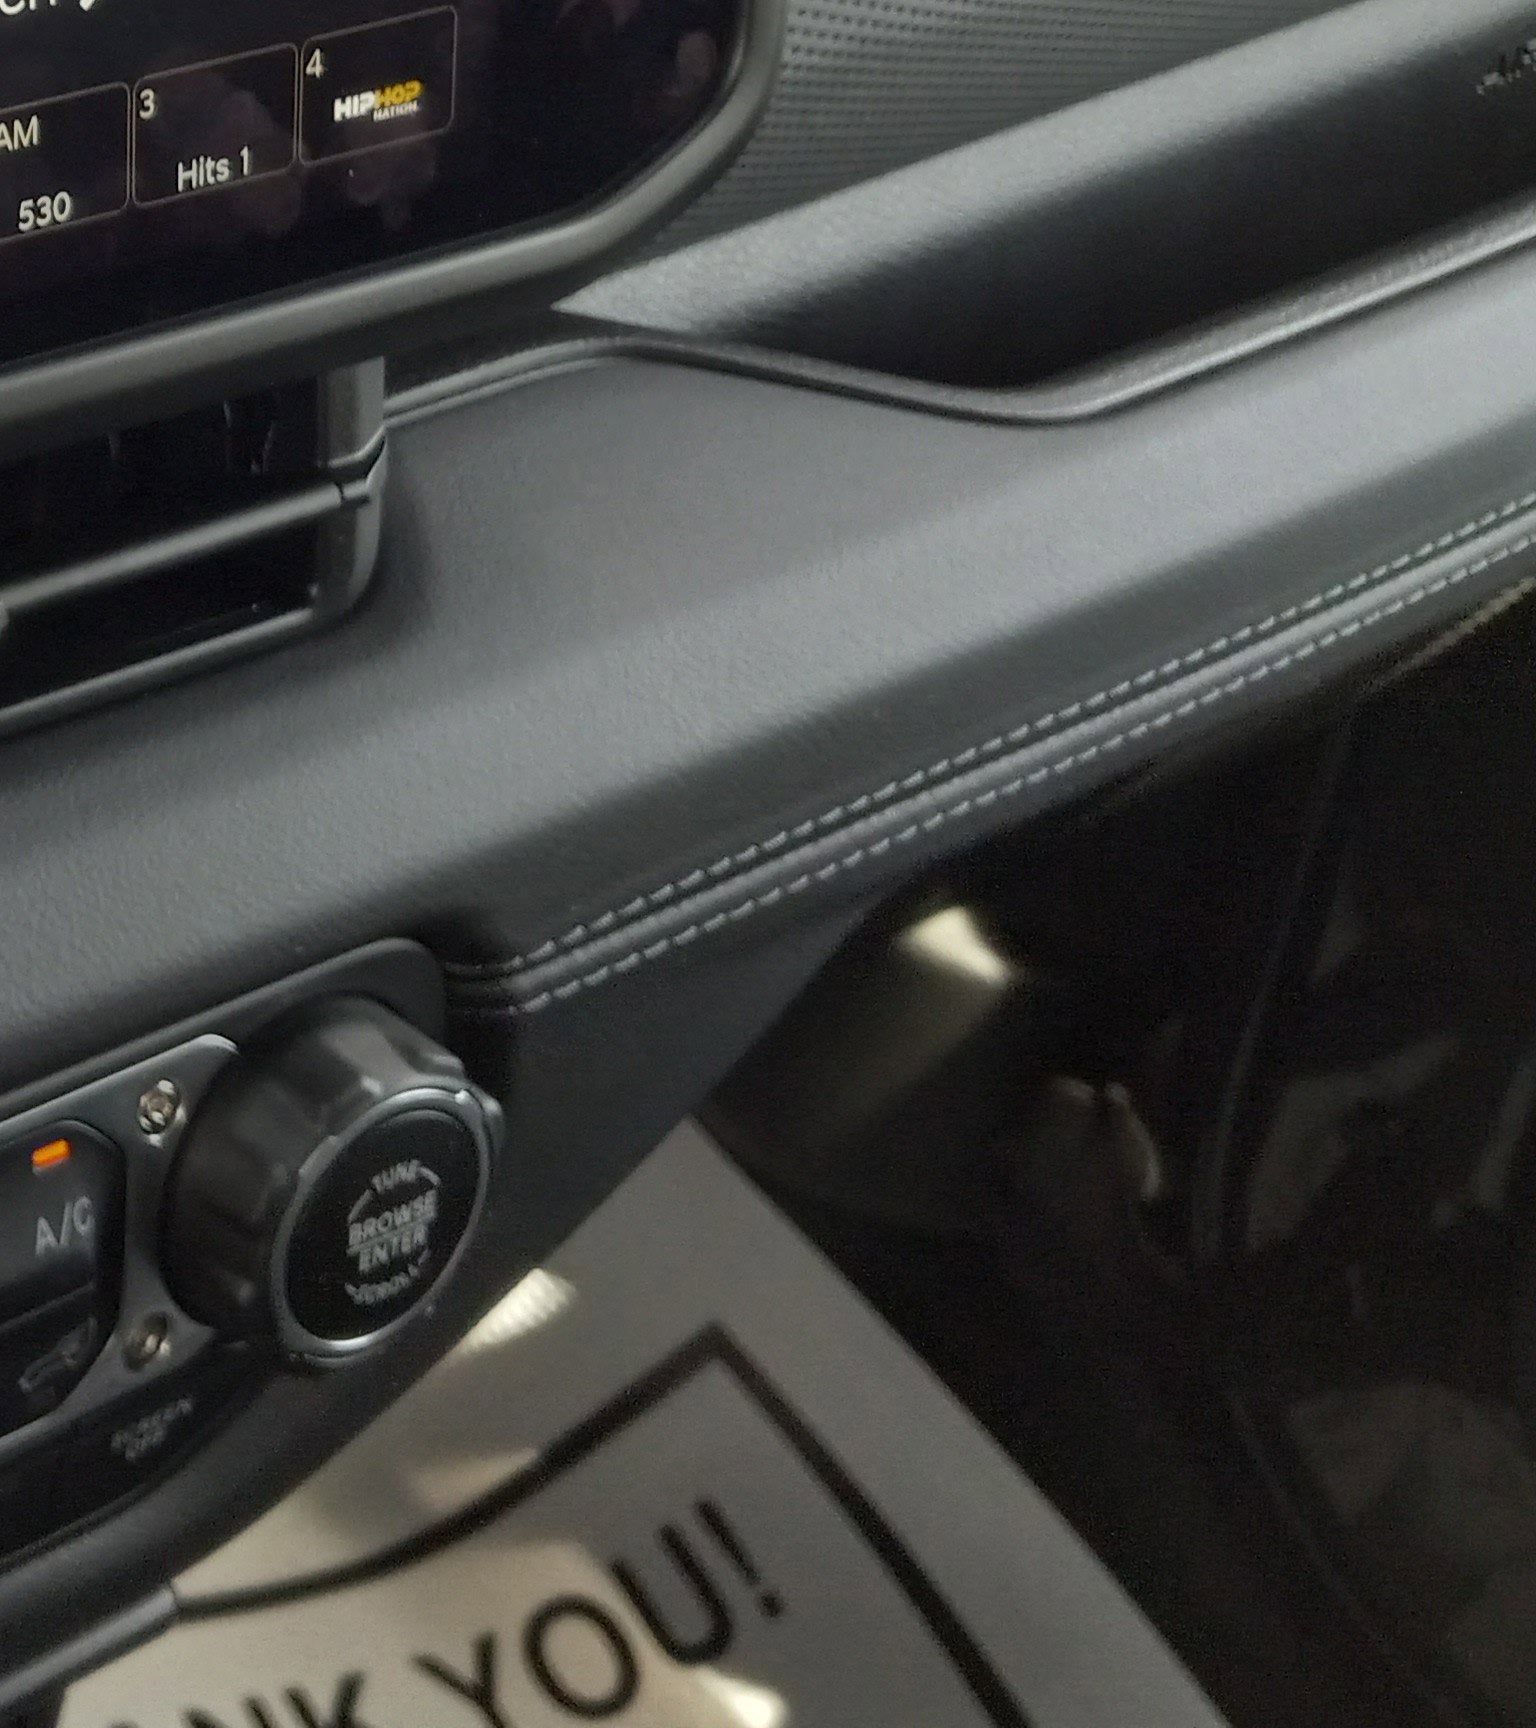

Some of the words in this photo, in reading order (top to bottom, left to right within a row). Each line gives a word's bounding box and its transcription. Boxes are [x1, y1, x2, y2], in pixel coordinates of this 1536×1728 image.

[306, 48, 324, 78] 4
[139, 88, 155, 120] 3
[177, 154, 230, 193] Hits
[239, 145, 250, 177] 1
[18, 191, 71, 234] 530
[35, 1195, 94, 1256] A/C
